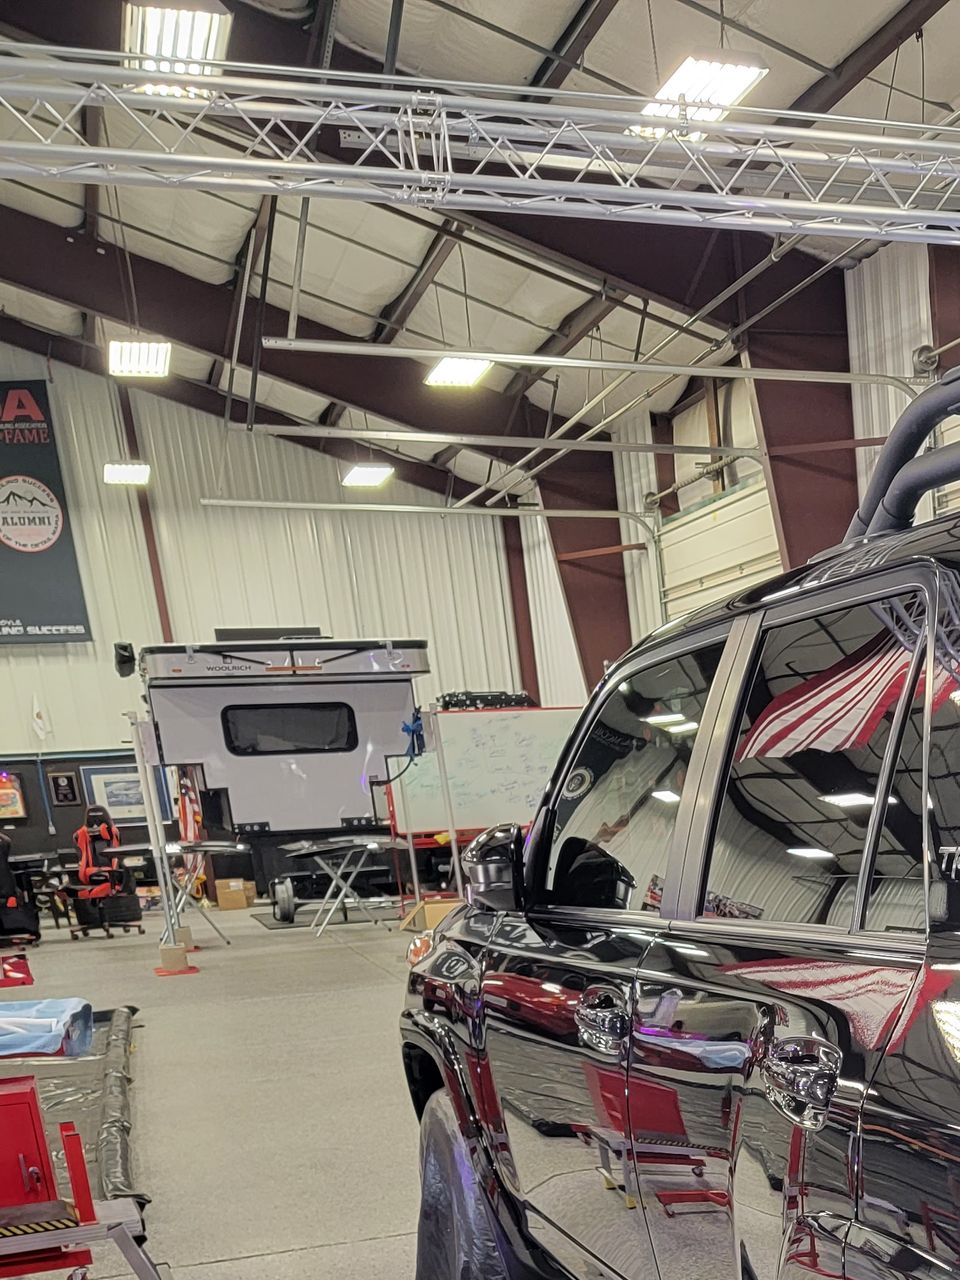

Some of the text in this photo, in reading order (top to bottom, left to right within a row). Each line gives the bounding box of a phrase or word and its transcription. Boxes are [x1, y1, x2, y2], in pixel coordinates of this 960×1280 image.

[4, 429, 50, 444] FAME
[1, 516, 52, 527] ALUMNI
[26, 624, 86, 635] SUCCESS
